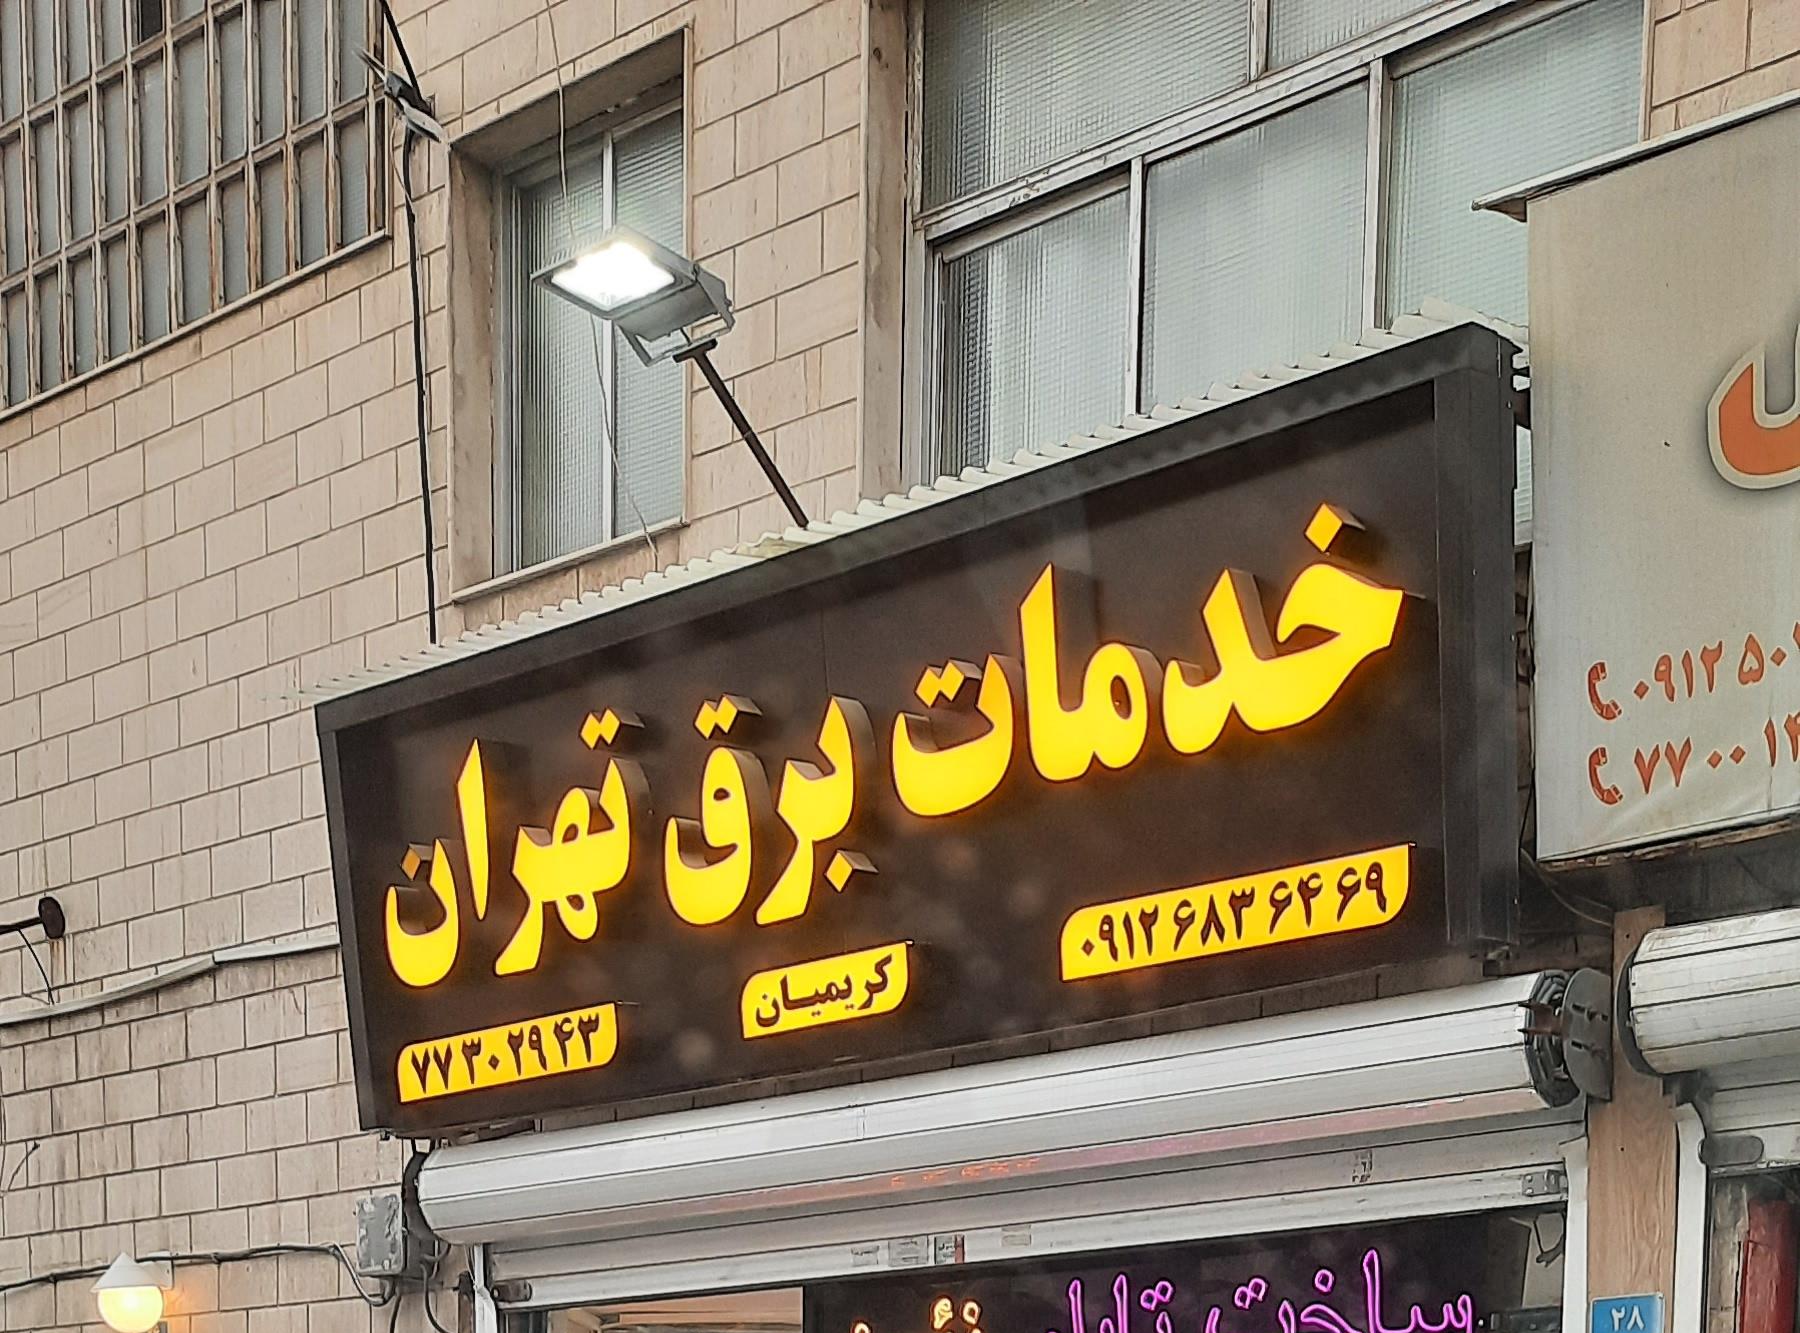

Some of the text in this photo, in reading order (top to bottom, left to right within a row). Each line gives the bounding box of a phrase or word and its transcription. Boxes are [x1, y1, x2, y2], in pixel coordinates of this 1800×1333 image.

[1634, 621, 1800, 703] ۰۹۱۲ ۵۰
[385, 502, 1403, 988] خدمات برق تهران
[755, 953, 893, 1028] کریمیان
[1611, 1304, 1645, 1332] ۲۸
